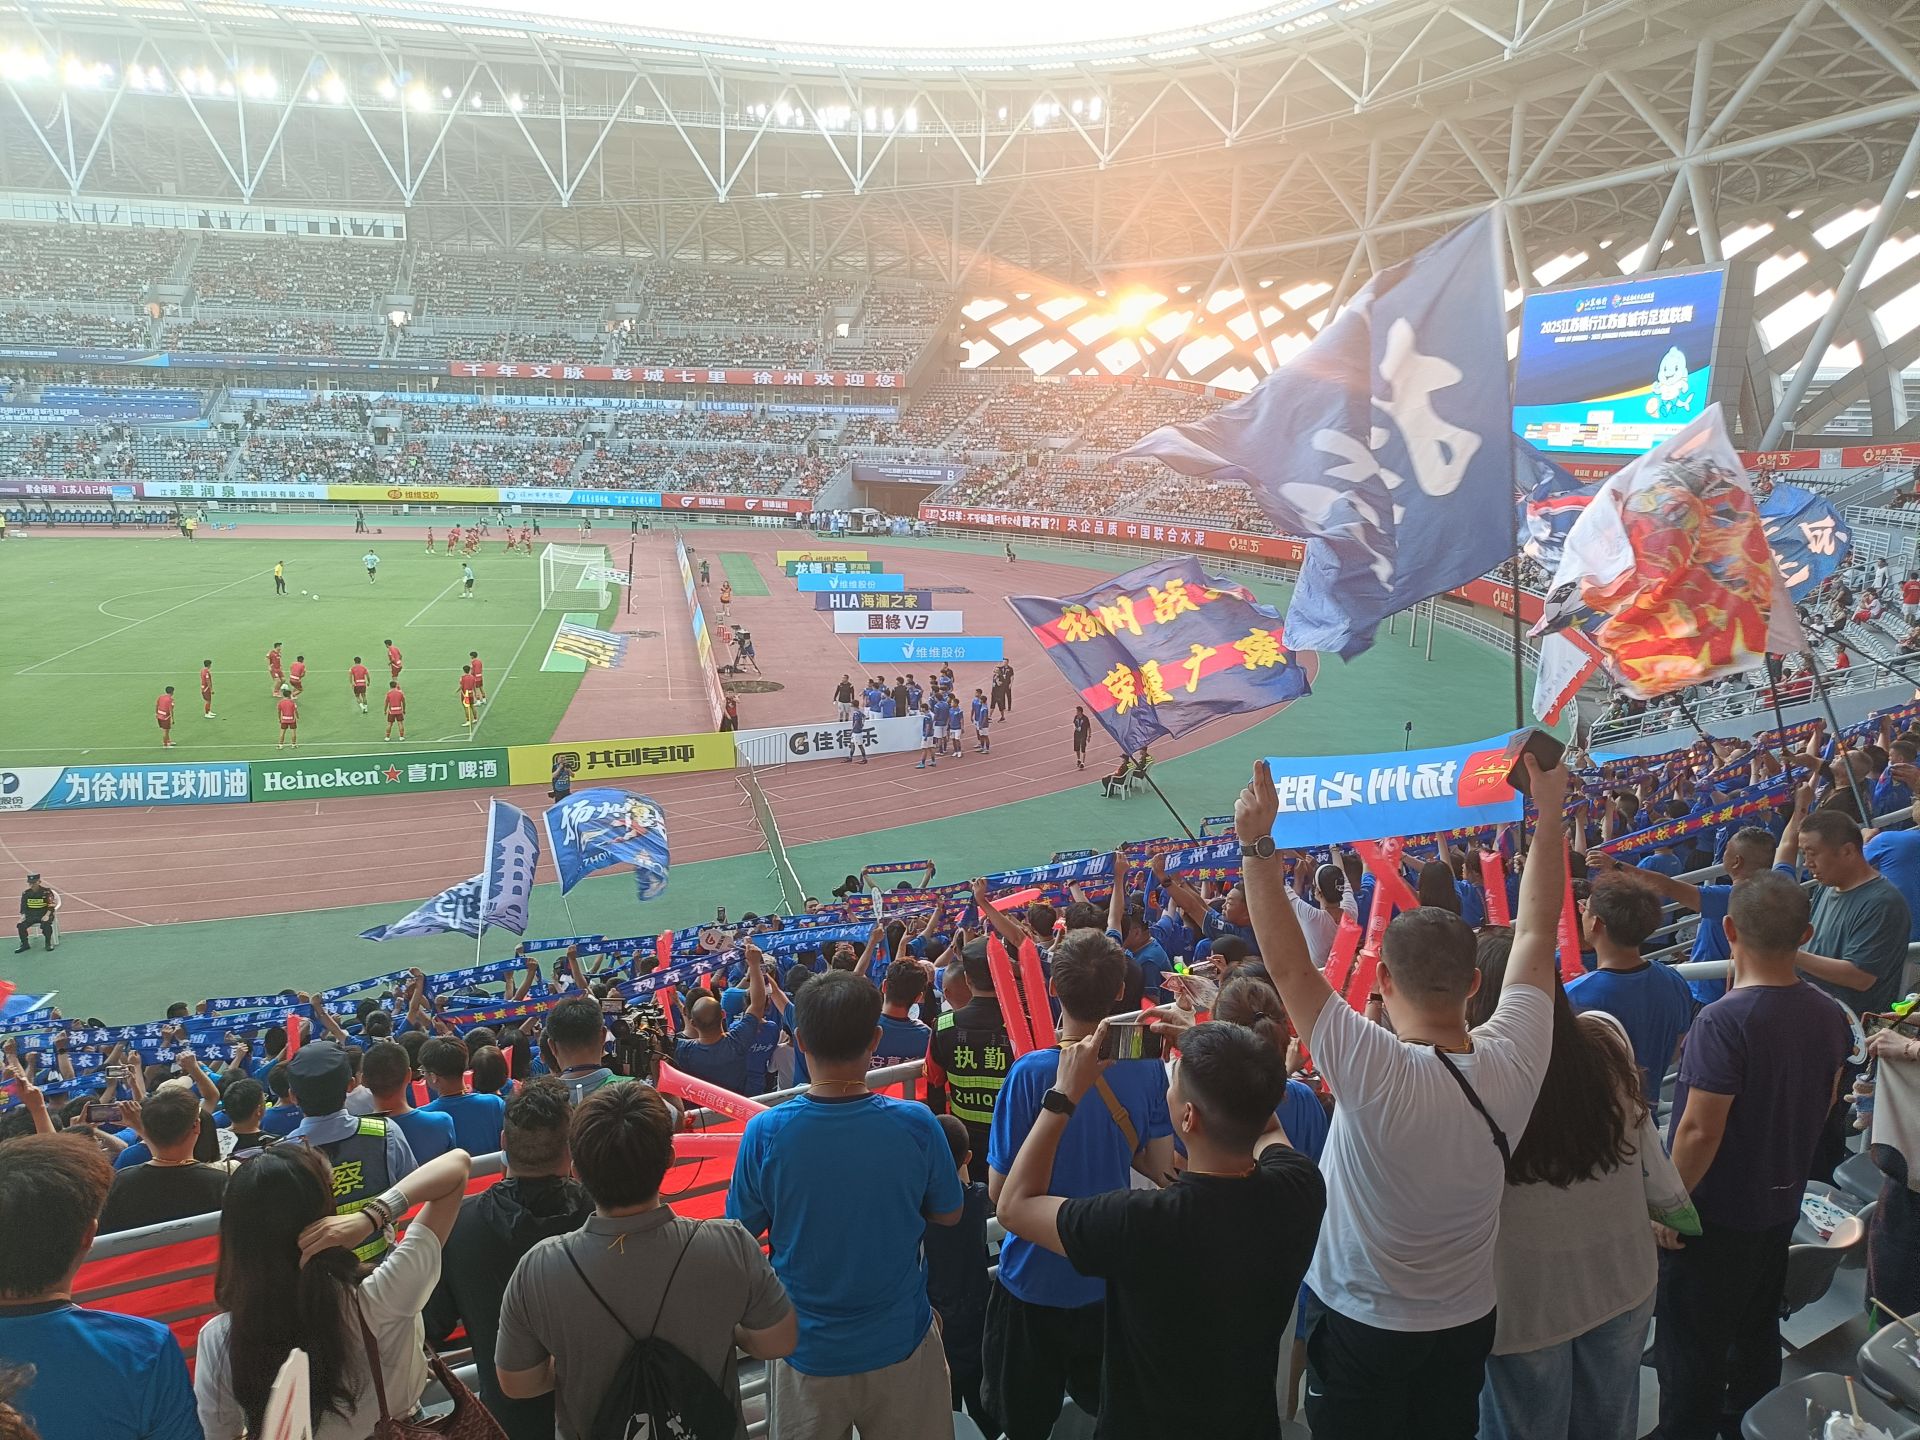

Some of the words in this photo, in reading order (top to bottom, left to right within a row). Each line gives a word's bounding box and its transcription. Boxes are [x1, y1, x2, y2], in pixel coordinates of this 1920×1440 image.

[463, 364, 585, 380] 千年文脉
[612, 368, 727, 384] 彭城七里
[753, 371, 896, 388] 徐州欢迎您
[180, 485, 236, 497] 翠润泉
[1067, 519, 1118, 537] 央企品质
[1127, 523, 1205, 546] 中国联合水泥
[829, 593, 860, 609] HLA
[861, 593, 918, 609] 海澜之家
[906, 614, 929, 630] V3
[915, 646, 966, 659] 维维股份
[813, 727, 879, 752] 佳得乐
[586, 743, 695, 768] 共创草坪
[65, 767, 248, 803] 为徐州足球加油
[263, 768, 380, 792] Heineken
[408, 762, 448, 783] 喜力
[459, 759, 497, 780] 啤酒
[954, 1045, 1006, 1071] 执勤
[955, 1088, 998, 1107] ZHIQ
[332, 1161, 364, 1198] 察
